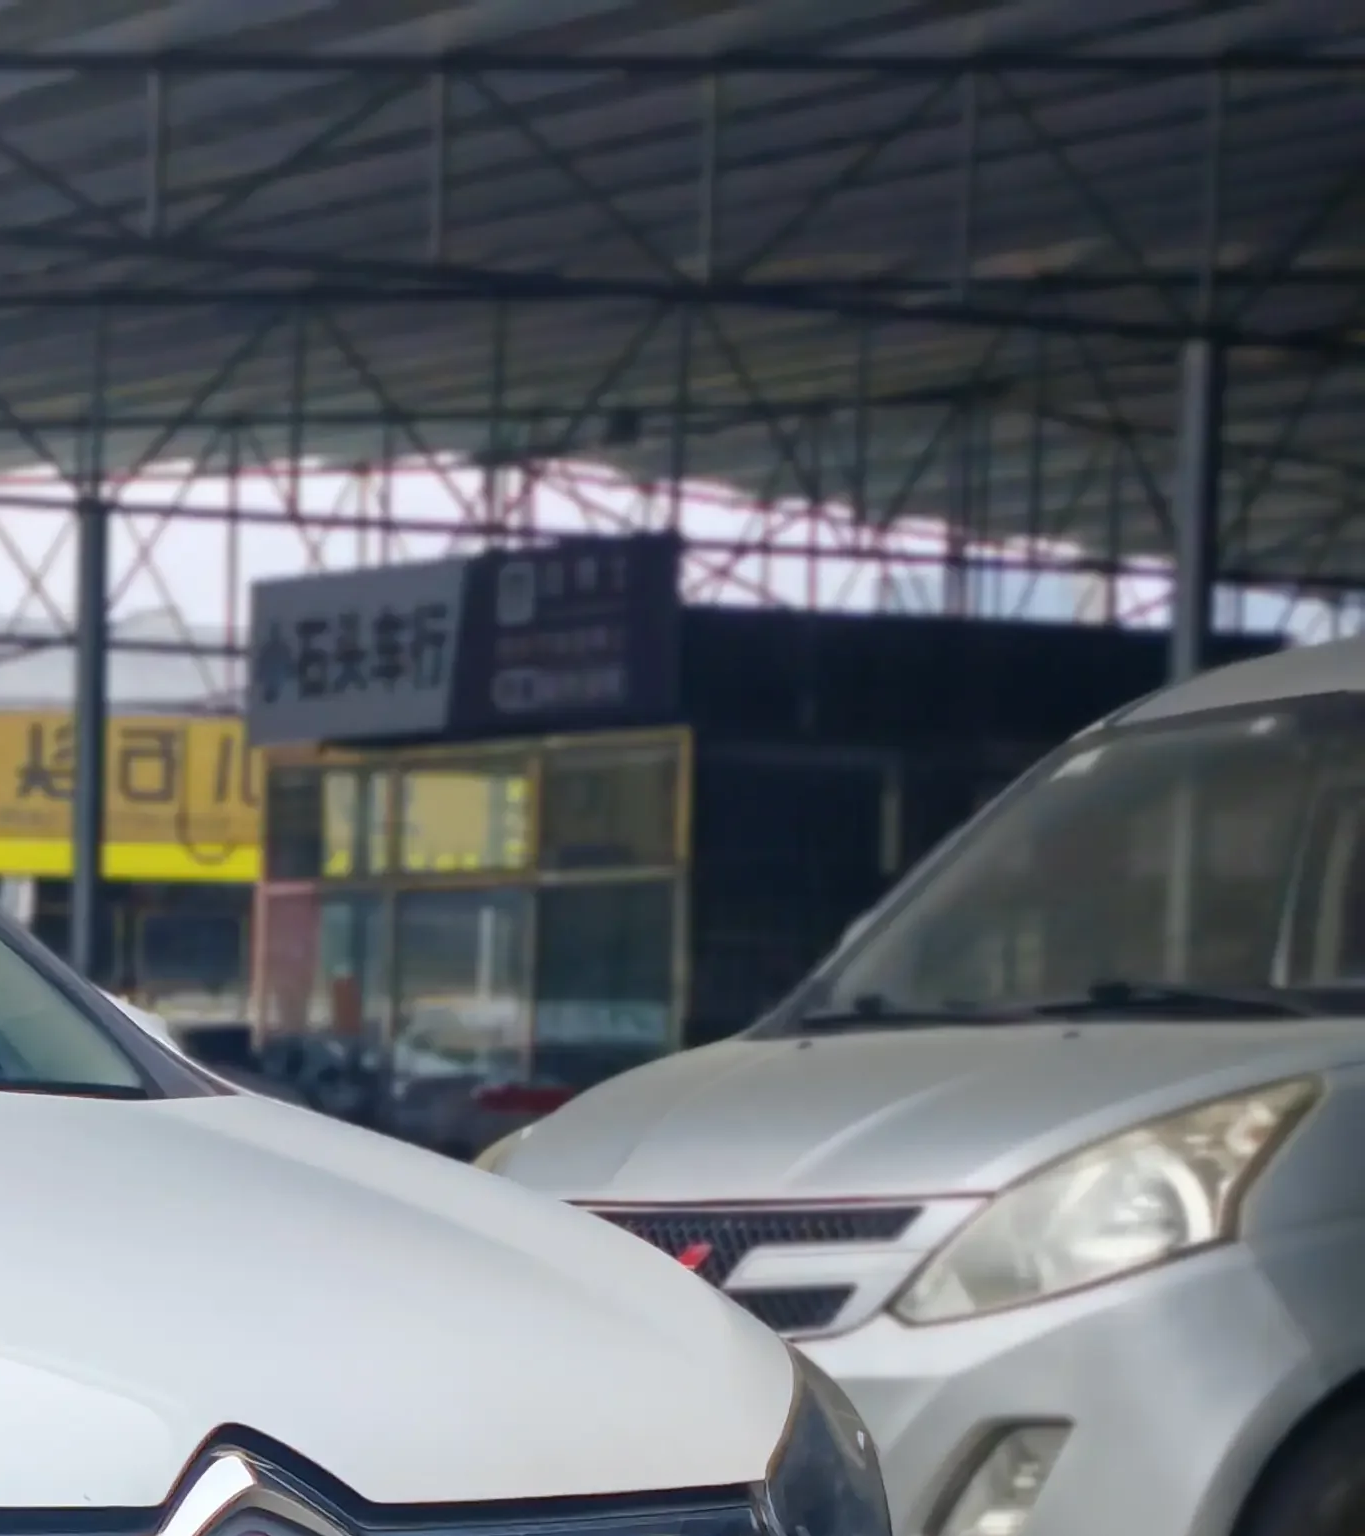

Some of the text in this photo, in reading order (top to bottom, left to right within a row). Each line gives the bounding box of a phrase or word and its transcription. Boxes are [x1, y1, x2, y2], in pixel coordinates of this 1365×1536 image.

[257, 603, 447, 704] 小石头车行
